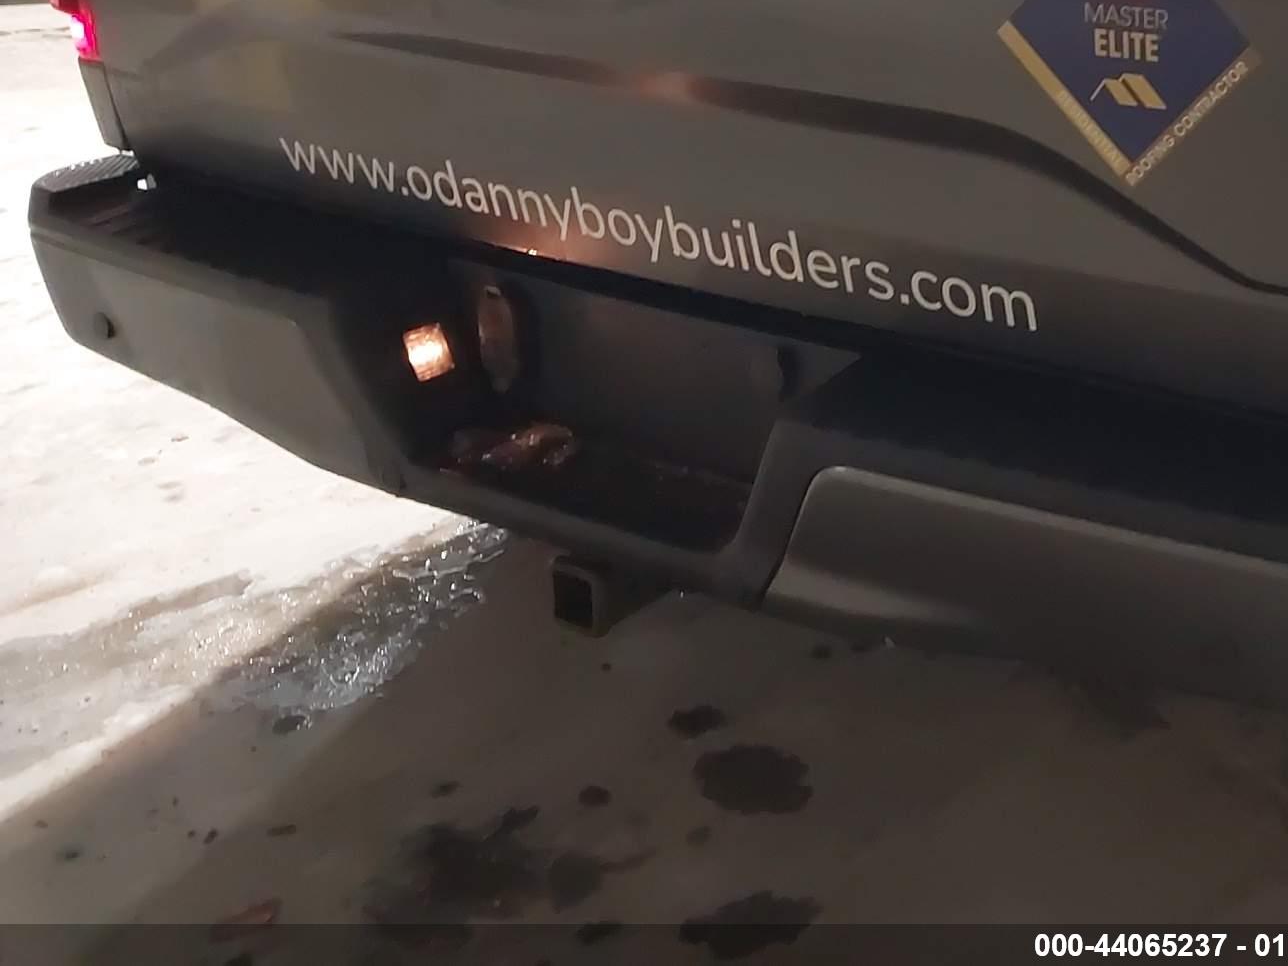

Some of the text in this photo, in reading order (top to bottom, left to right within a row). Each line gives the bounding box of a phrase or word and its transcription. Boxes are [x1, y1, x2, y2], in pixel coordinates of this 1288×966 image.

[1083, 1, 1169, 30] MASTER
[1093, 28, 1160, 63] ELITE
[1124, 59, 1250, 187] ROOFING CONTRACTOR
[280, 136, 1039, 332] www.odannyboybuilders.com
